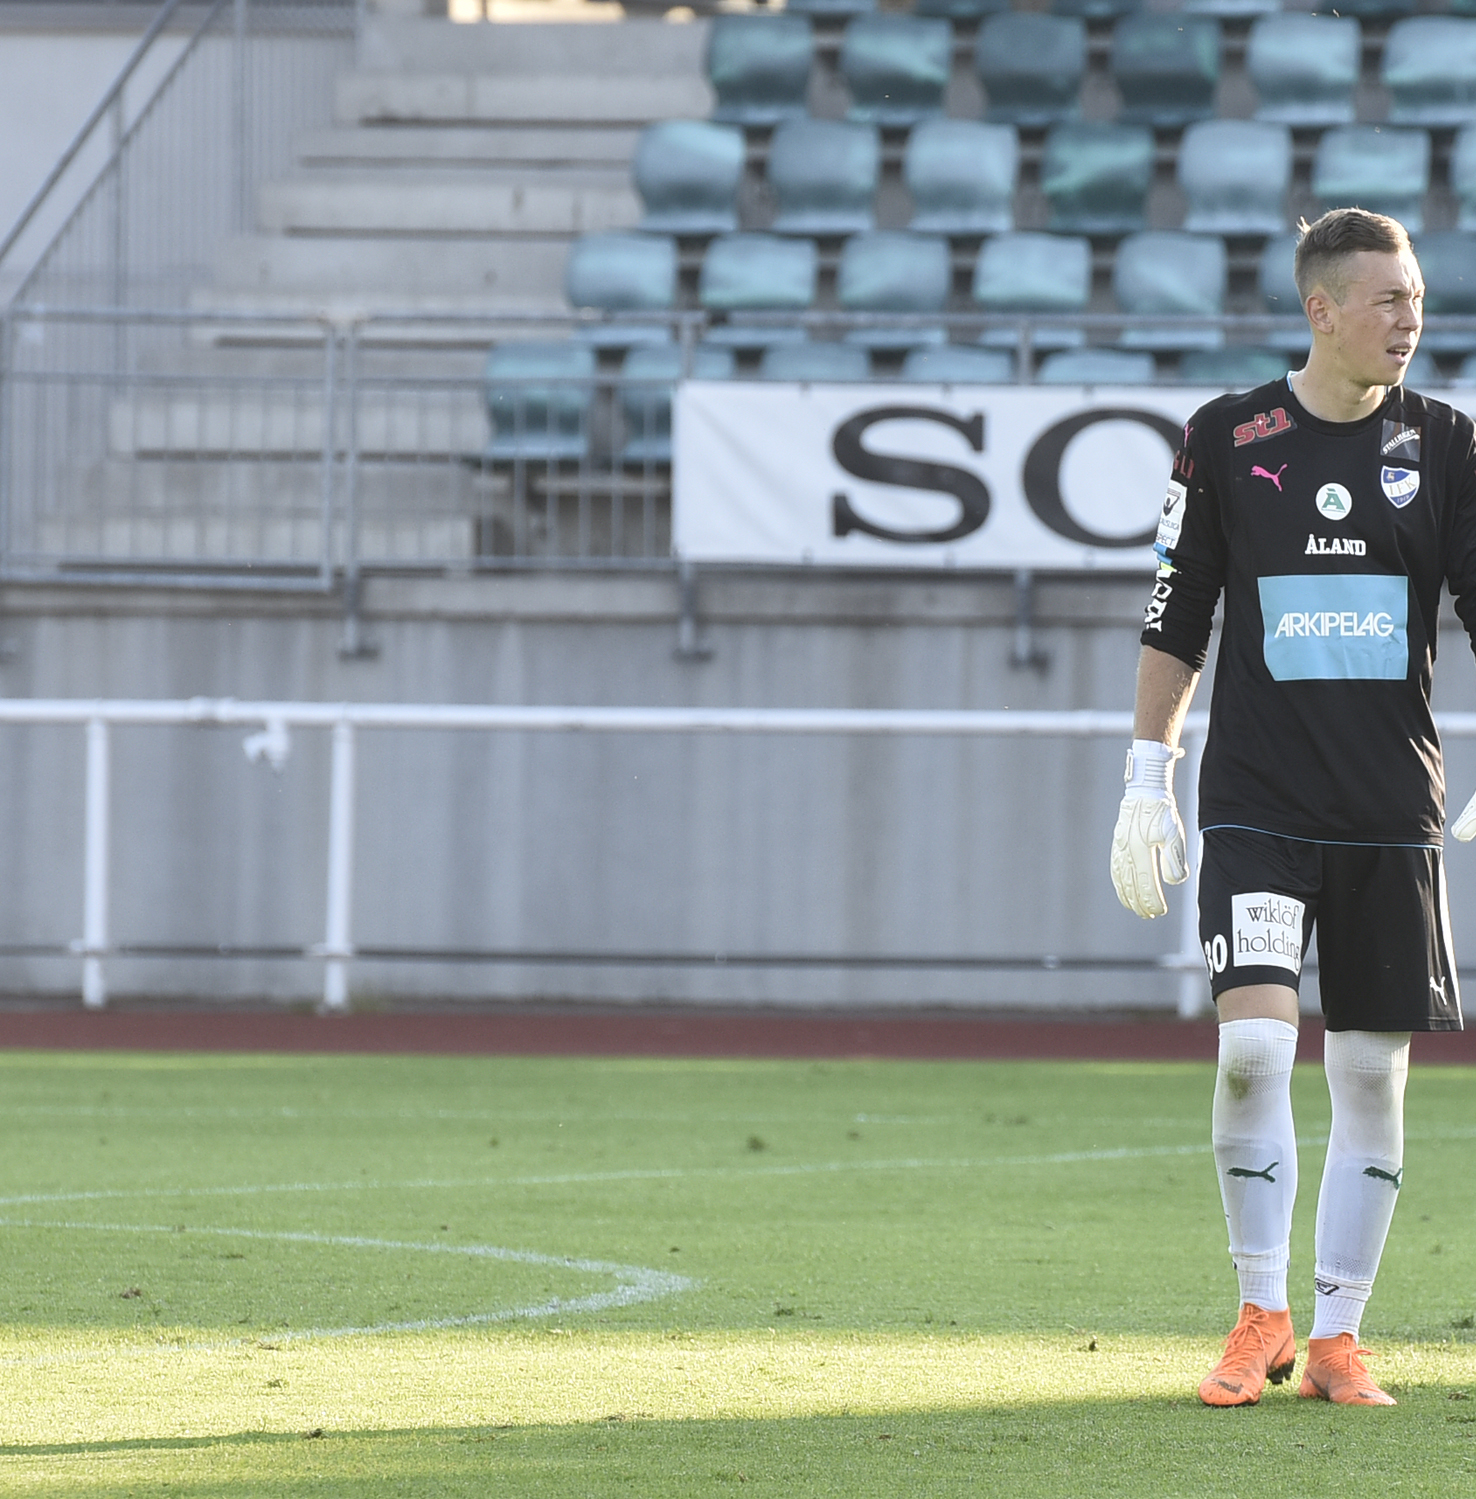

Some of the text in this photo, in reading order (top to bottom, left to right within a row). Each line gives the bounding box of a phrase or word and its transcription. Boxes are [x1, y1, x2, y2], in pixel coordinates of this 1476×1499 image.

[1233, 407, 1292, 448] st1
[1388, 476, 1416, 496] IFK
[1304, 533, 1367, 556] ÅLAND
[1274, 611, 1395, 638] ARKIPELAG
[1245, 898, 1300, 929] wiklöf
[1236, 928, 1301, 972] holding
